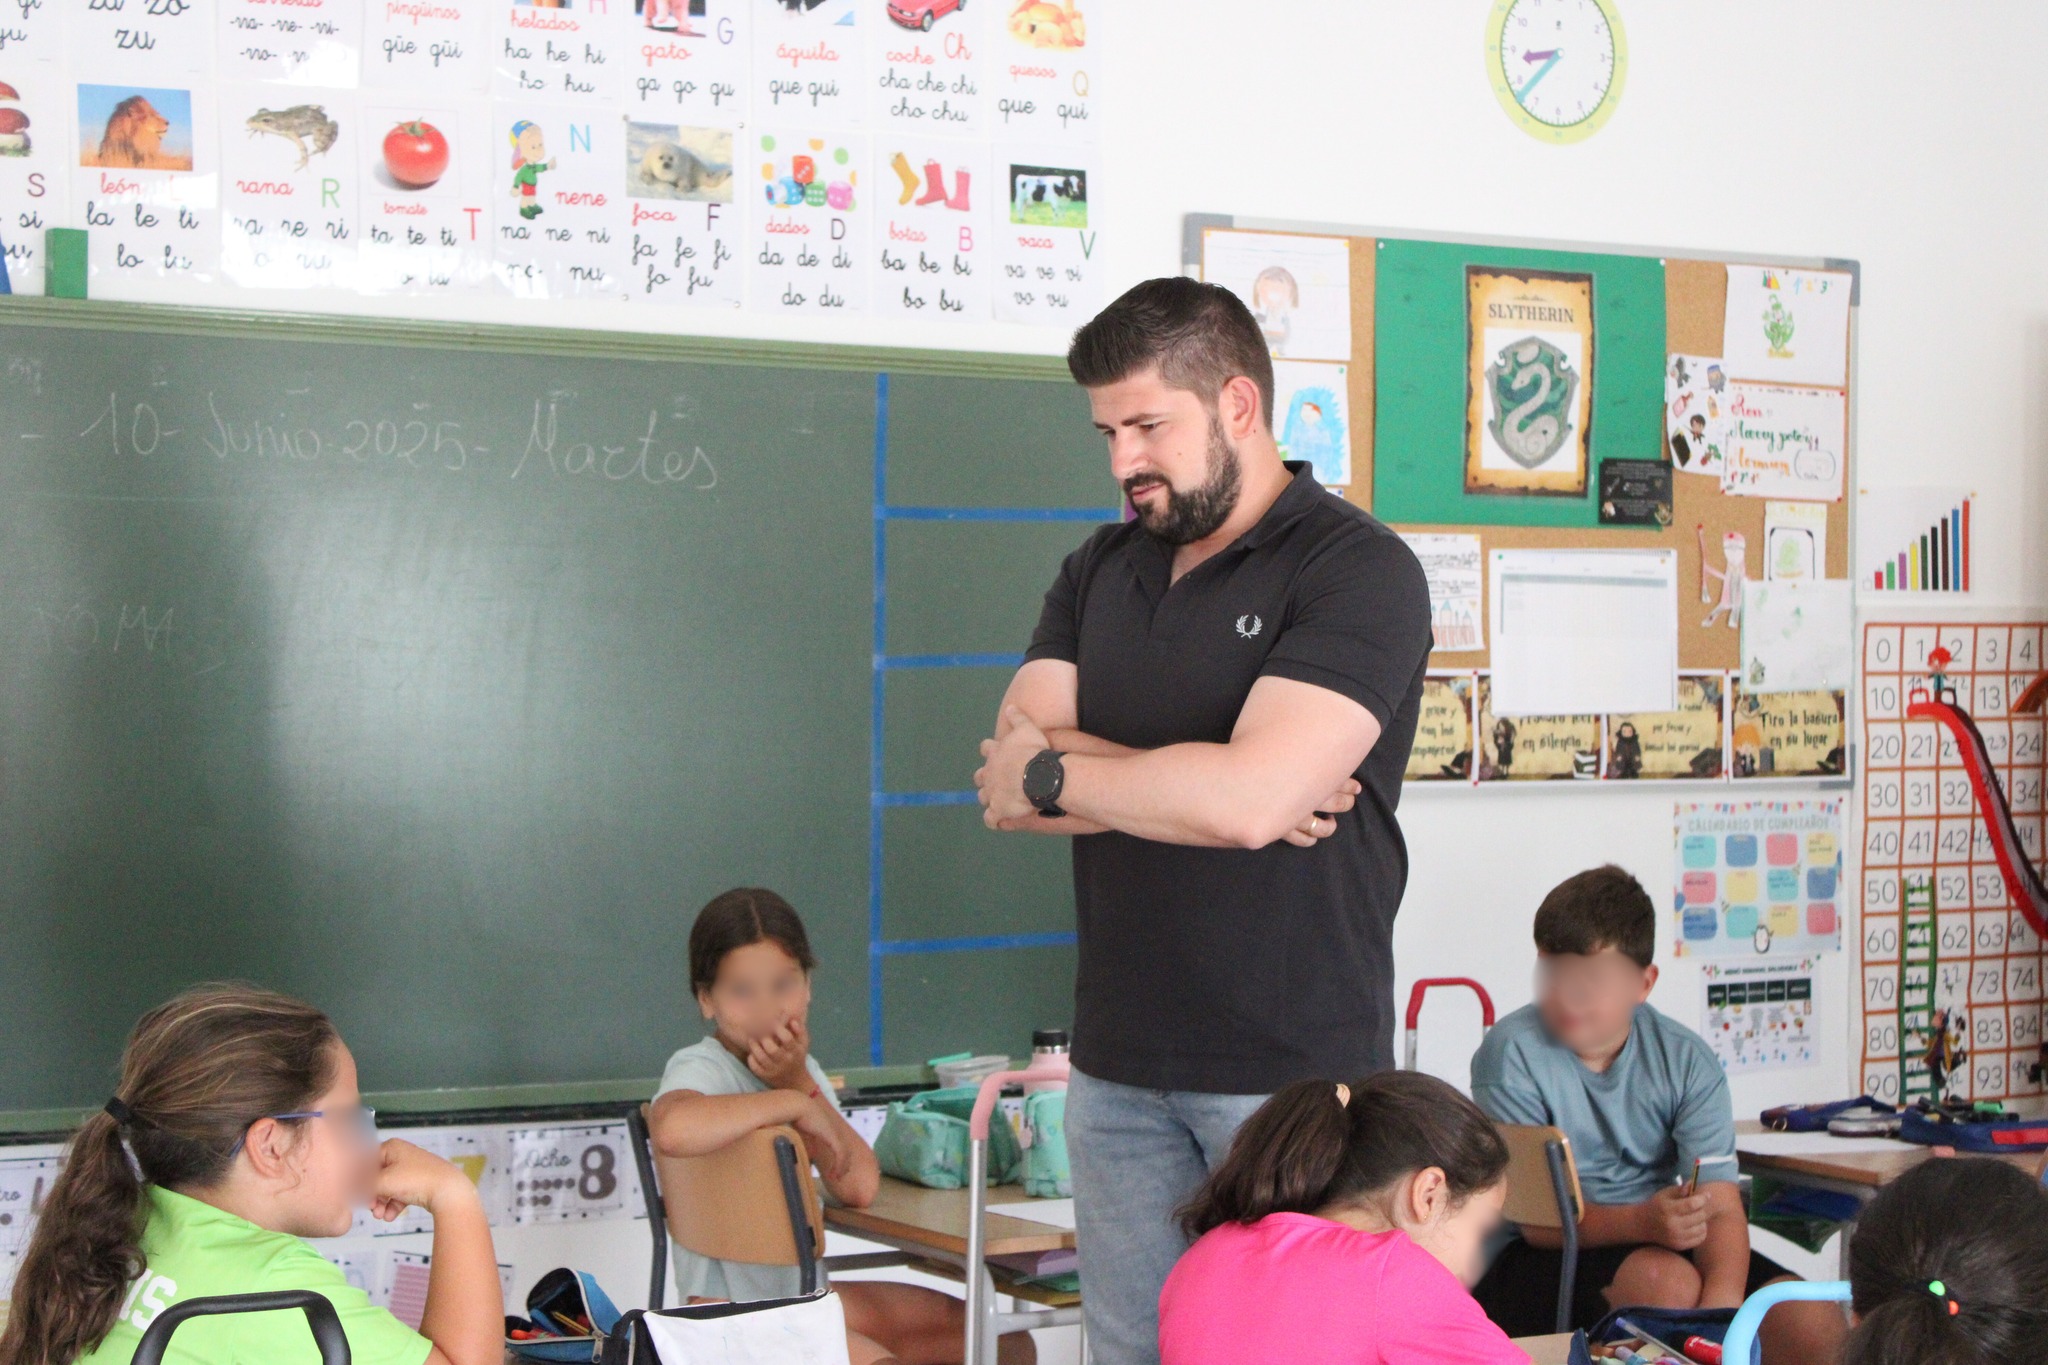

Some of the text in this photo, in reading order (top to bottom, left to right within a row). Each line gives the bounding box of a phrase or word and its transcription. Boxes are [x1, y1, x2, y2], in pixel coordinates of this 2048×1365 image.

[511, 9, 580, 31] helados
[717, 17, 734, 45] G
[1517, 18, 1528, 27] 10
[115, 29, 155, 50] zu
[505, 38, 605, 64] ha he hi
[944, 32, 972, 60] Ch
[641, 42, 692, 67] gato
[776, 41, 839, 68] águila
[887, 46, 935, 65] coche
[565, 73, 595, 93] hu
[880, 68, 977, 95] cha che chi
[1010, 64, 1057, 82] quesos
[1073, 71, 1088, 96] Q
[637, 78, 735, 106] ga go gu
[891, 97, 968, 122] cho chu
[999, 99, 1088, 128] que qui
[570, 124, 591, 153] N
[28, 173, 45, 197] S
[101, 172, 141, 195] león
[236, 180, 294, 195] rana
[322, 178, 340, 208] R
[384, 202, 428, 215] tomate
[555, 192, 607, 206] nene
[20, 211, 43, 229] si
[86, 201, 199, 229] la le li
[463, 208, 482, 240] T
[632, 203, 677, 227] foca
[708, 203, 721, 230] F
[766, 216, 810, 235] dados
[281, 219, 308, 237] re
[326, 218, 349, 239] ri
[371, 225, 457, 246] ta te ti
[501, 226, 610, 243] na ne ni
[831, 218, 845, 240] D
[889, 221, 927, 242] botas
[959, 226, 973, 252] B
[117, 243, 143, 268] lo
[632, 234, 731, 270] fa fe fi
[759, 242, 851, 268] da de di
[1018, 237, 1054, 249] vaca
[1079, 230, 1096, 260] V
[570, 265, 605, 282] nu
[881, 249, 971, 275] ba be bi
[1005, 265, 1081, 281] va ve vi
[646, 264, 713, 295] fo fu
[782, 283, 844, 307] do du
[903, 287, 963, 312] bo bu
[1014, 292, 1068, 307] vo vu
[1488, 303, 1574, 323] SLYTHERIN
[1876, 638, 2032, 663] 0 1 2 3 4
[1870, 687, 1896, 711] 10
[1979, 685, 2001, 710] 13
[1759, 711, 1785, 731] Tiro
[1789, 709, 1798, 727] la
[1803, 730, 1828, 749] lugar
[1871, 735, 1900, 759] 20
[1910, 735, 1933, 758] 21
[1986, 736, 2008, 750] 23
[2015, 734, 2041, 756] 24
[1870, 783, 1899, 808] 30
[1910, 783, 1931, 806] 31
[1943, 782, 1969, 806] 32
[2015, 781, 2039, 804] 34
[1869, 831, 1898, 856] 40
[1908, 831, 1931, 854] 41
[1941, 829, 1968, 854] 42
[1867, 879, 1897, 904] 50
[1941, 877, 1966, 900] 52
[1976, 876, 2002, 899] 53
[1867, 918, 2025, 954] 60 62 63 64
[1868, 977, 1894, 1002] 70
[1976, 972, 1999, 995] 73
[2012, 968, 2034, 990] 74
[1869, 1016, 2038, 1051] 80 83 84
[1867, 1074, 1898, 1099] 90
[1977, 1064, 2003, 1089] 93
[525, 1148, 572, 1169] Ocho
[579, 1144, 617, 1200] 8
